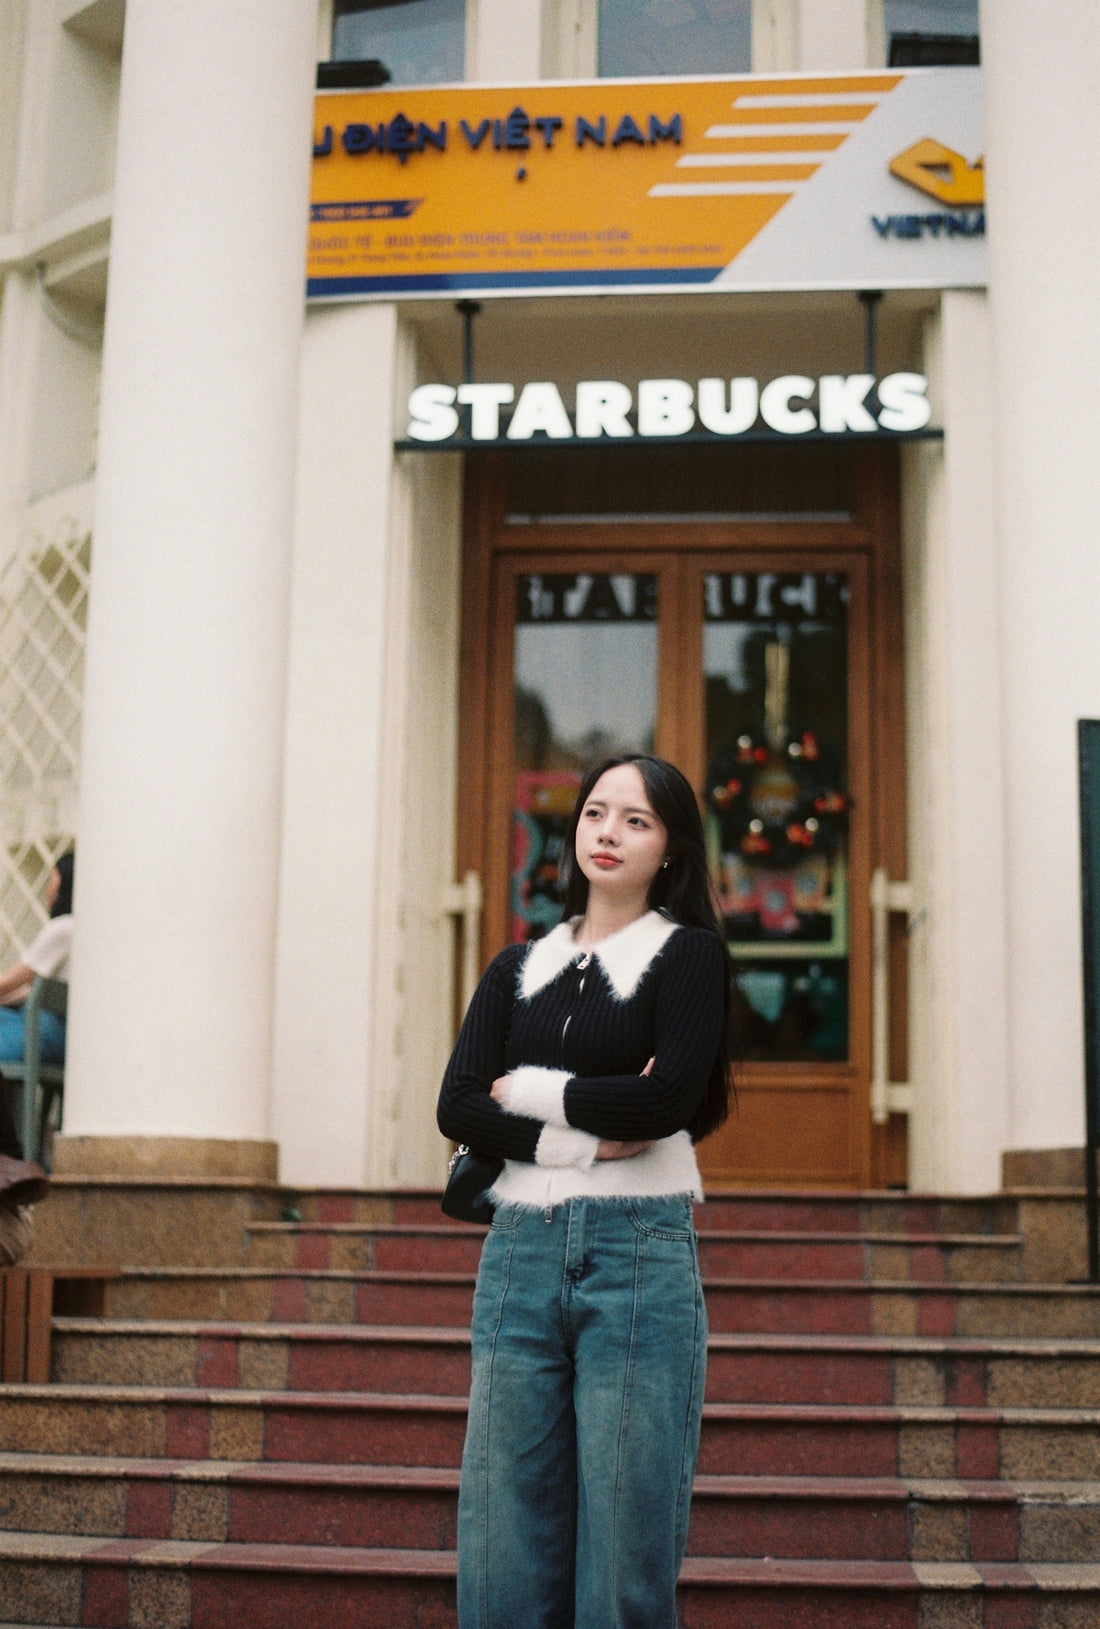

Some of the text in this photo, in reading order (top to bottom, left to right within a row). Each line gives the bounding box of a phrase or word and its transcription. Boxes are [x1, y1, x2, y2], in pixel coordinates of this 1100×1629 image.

[342, 112, 447, 164] ĐIỆN
[459, 106, 562, 181] VIỆT
[576, 113, 682, 148] NAM
[407, 372, 932, 441] STARBUCKS
